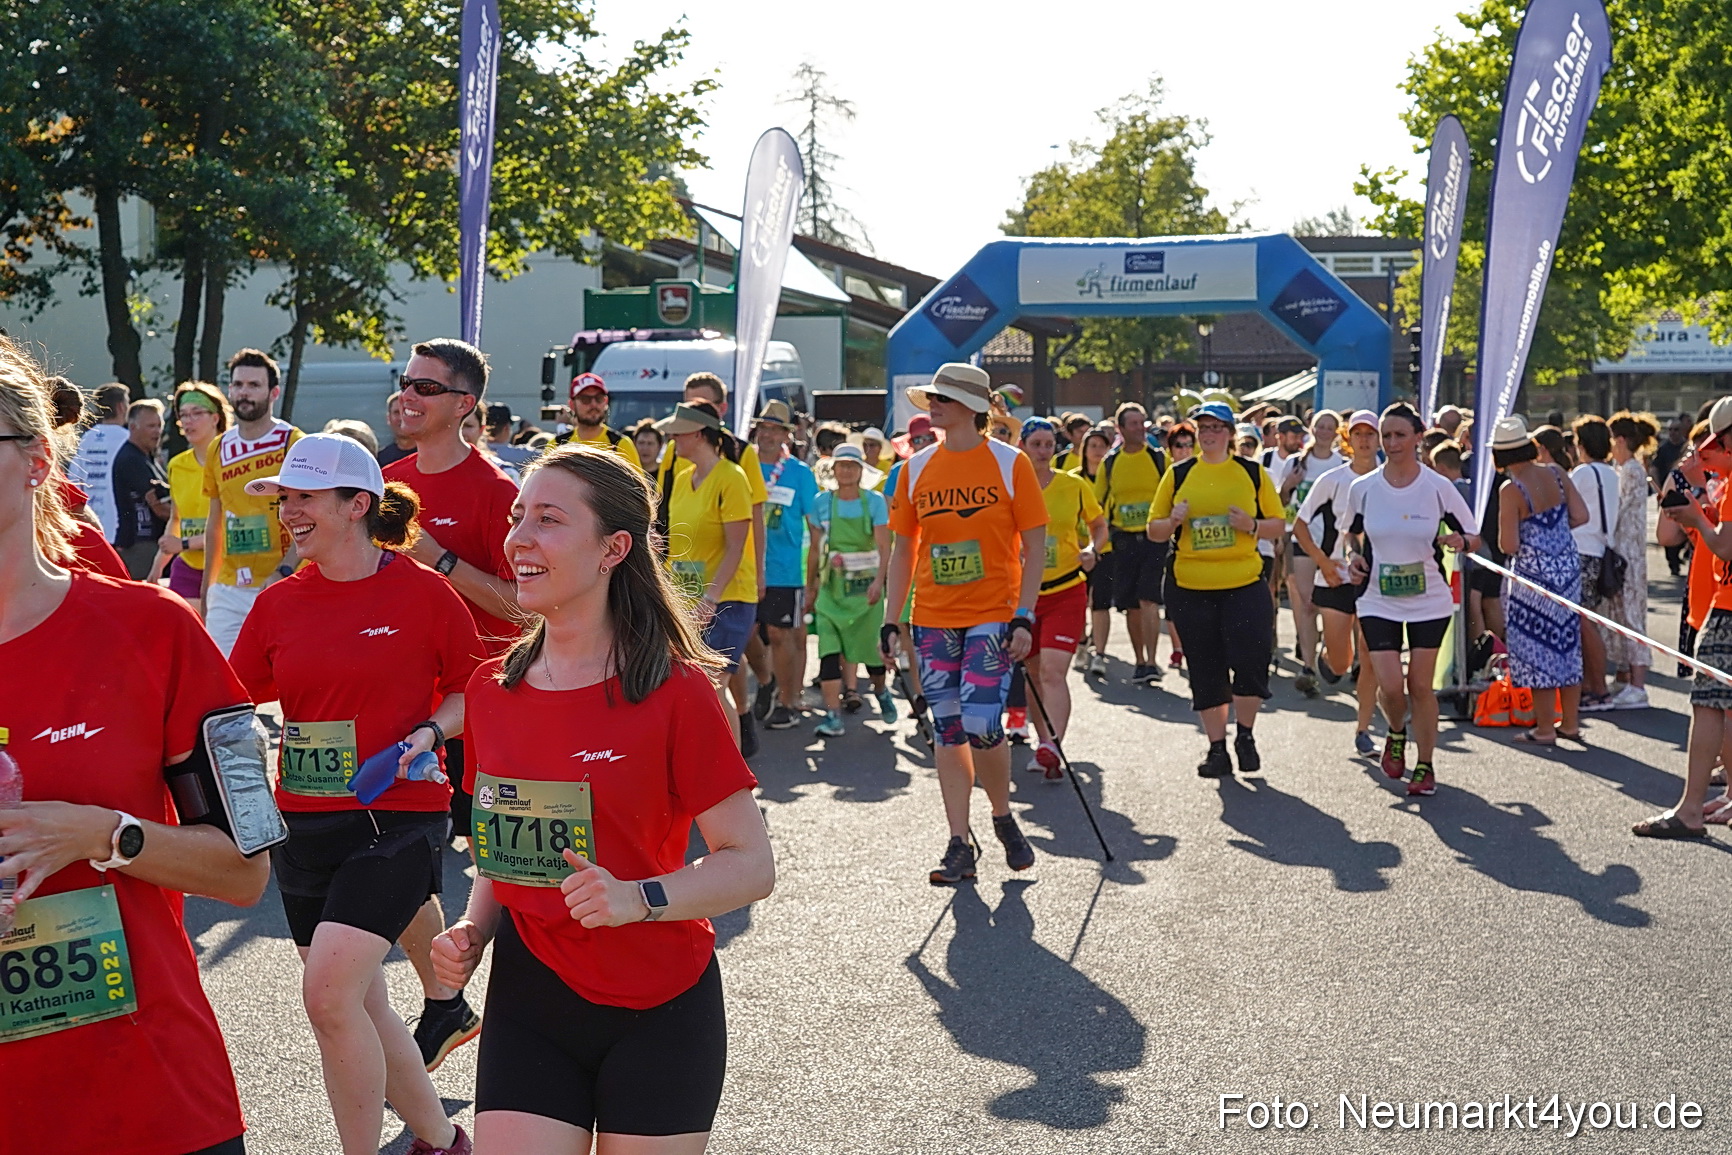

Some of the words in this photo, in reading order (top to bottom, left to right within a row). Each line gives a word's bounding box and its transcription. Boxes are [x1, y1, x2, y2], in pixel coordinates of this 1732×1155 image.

[1531, 12, 1584, 157] Fischer
[1554, 36, 1593, 152] AUTOMOBILE
[1437, 140, 1458, 241] Fischer
[1110, 272, 1199, 291] firmenlauf
[941, 303, 990, 315] Fischer
[1490, 239, 1551, 440] ww.fischer-automobile.de
[222, 464, 252, 482] MAX
[255, 453, 285, 471] BÖG
[290, 463, 314, 471] quattro
[314, 466, 328, 476] Cup
[928, 486, 999, 507] WINGS
[435, 517, 452, 526] DEHN
[232, 529, 255, 543] 811
[1197, 526, 1227, 539] 1261
[941, 556, 967, 572] 577
[1387, 574, 1419, 587] 1319
[368, 626, 390, 637] DEHN
[50, 722, 87, 744] DEHN
[284, 746, 341, 773] 1713
[581, 749, 613, 763] DEHN
[307, 774, 345, 783] Susanne
[495, 798, 531, 806] Firmenlauf
[477, 822, 489, 858] RUN
[488, 813, 571, 854] 1718
[573, 826, 589, 861] 022
[493, 850, 535, 866] Wagner
[537, 856, 569, 871] Katja
[2, 933, 36, 946] neumarkt
[0, 938, 98, 995] 685
[100, 940, 126, 1000] 2022
[11, 989, 96, 1015] Katharina
